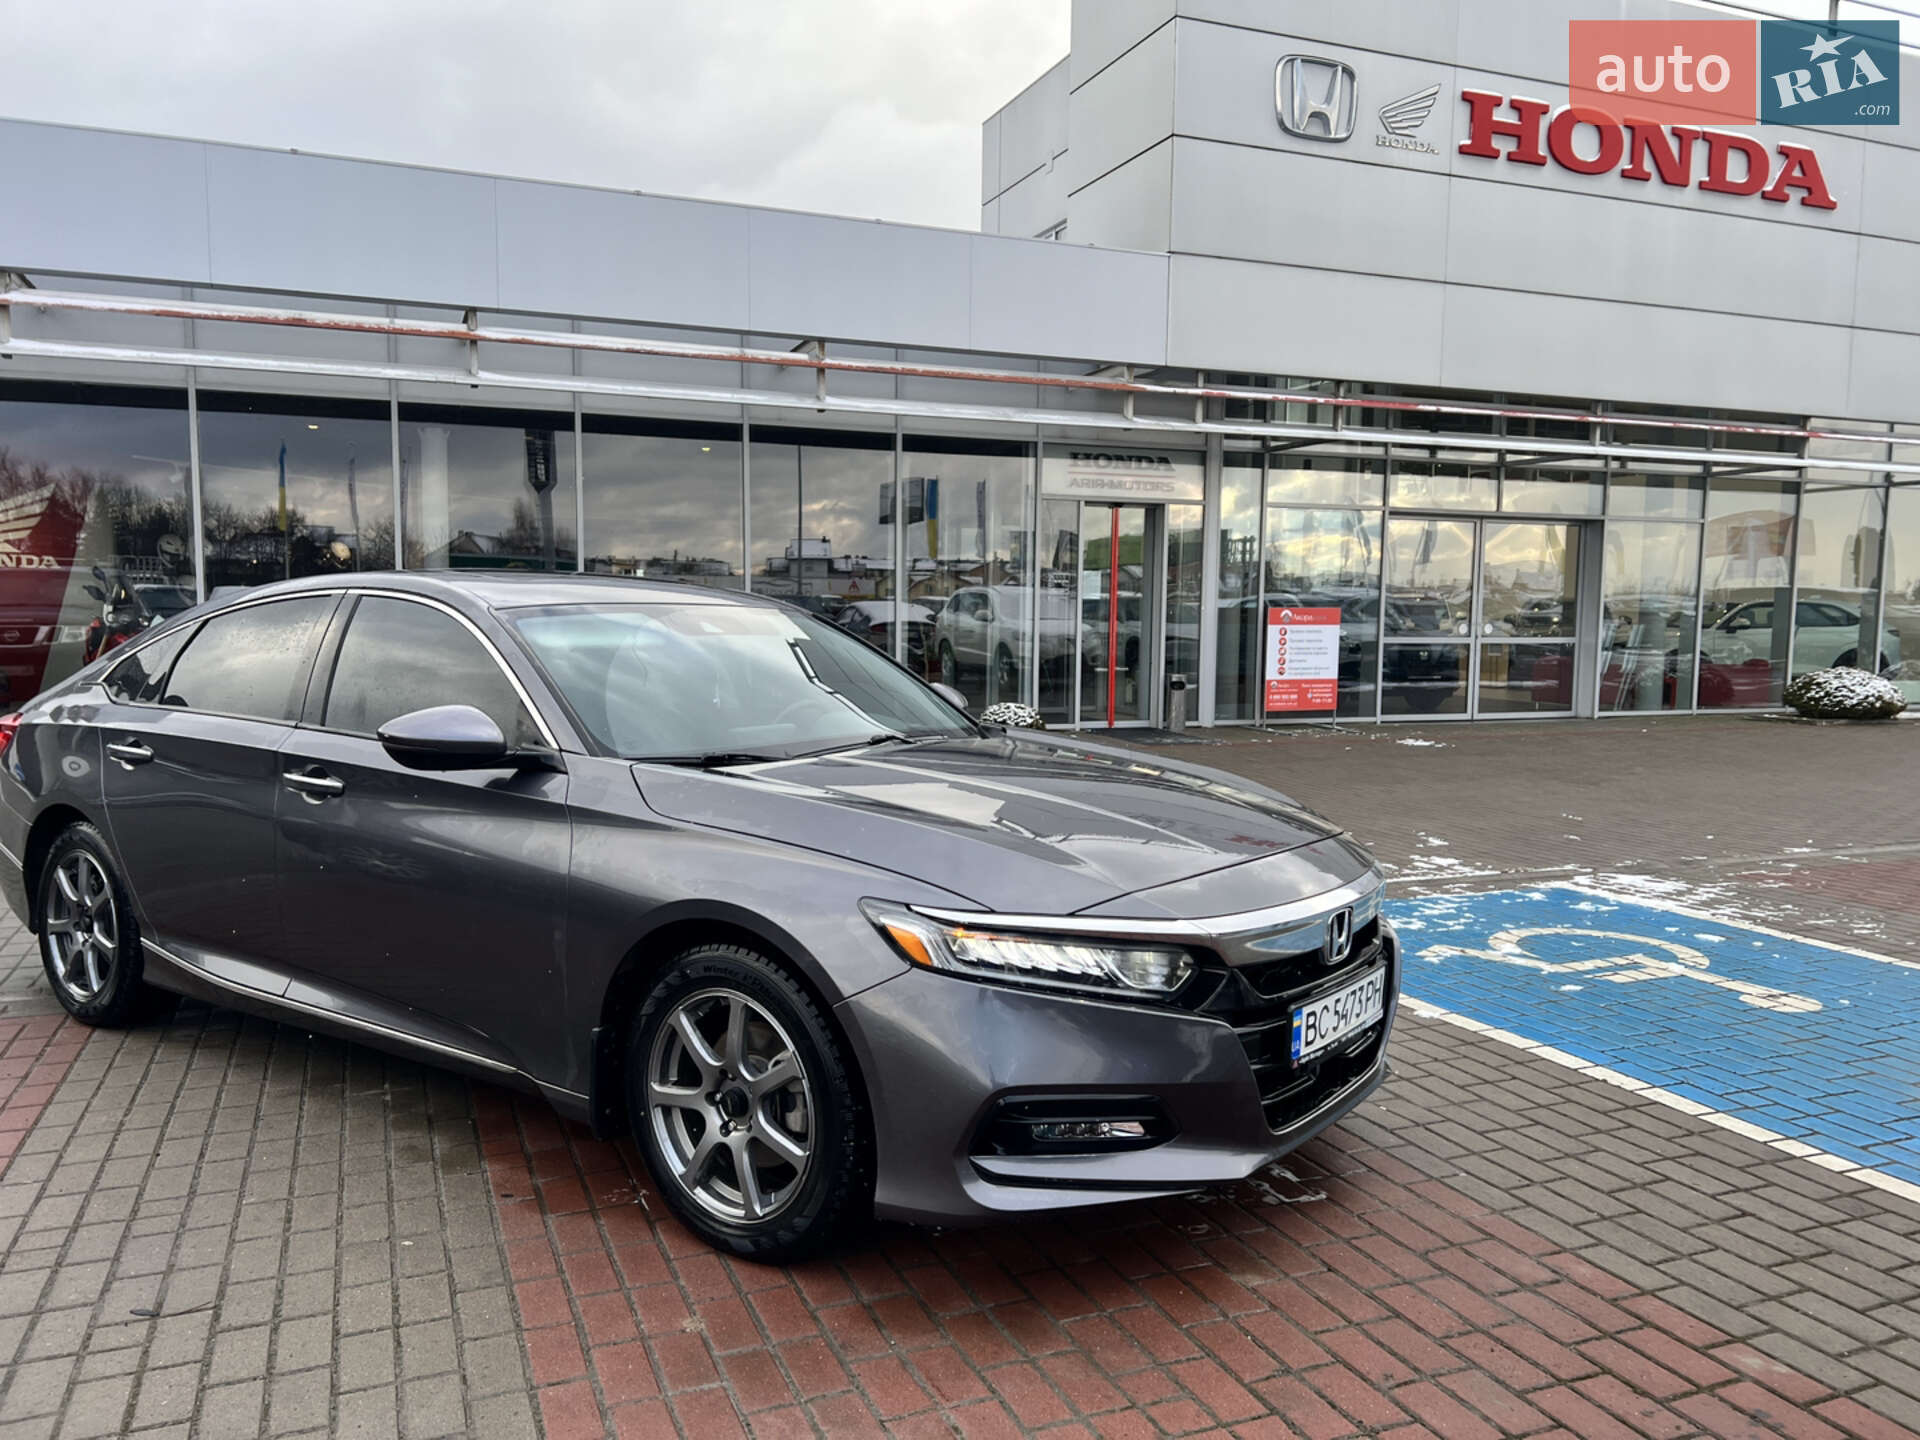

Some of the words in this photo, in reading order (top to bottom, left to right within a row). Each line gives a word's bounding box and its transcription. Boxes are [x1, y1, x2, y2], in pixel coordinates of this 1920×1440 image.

[1376, 134, 1441, 156] HONDA
[1458, 88, 1838, 211] HONDA
[1068, 452, 1177, 472] HONDA
